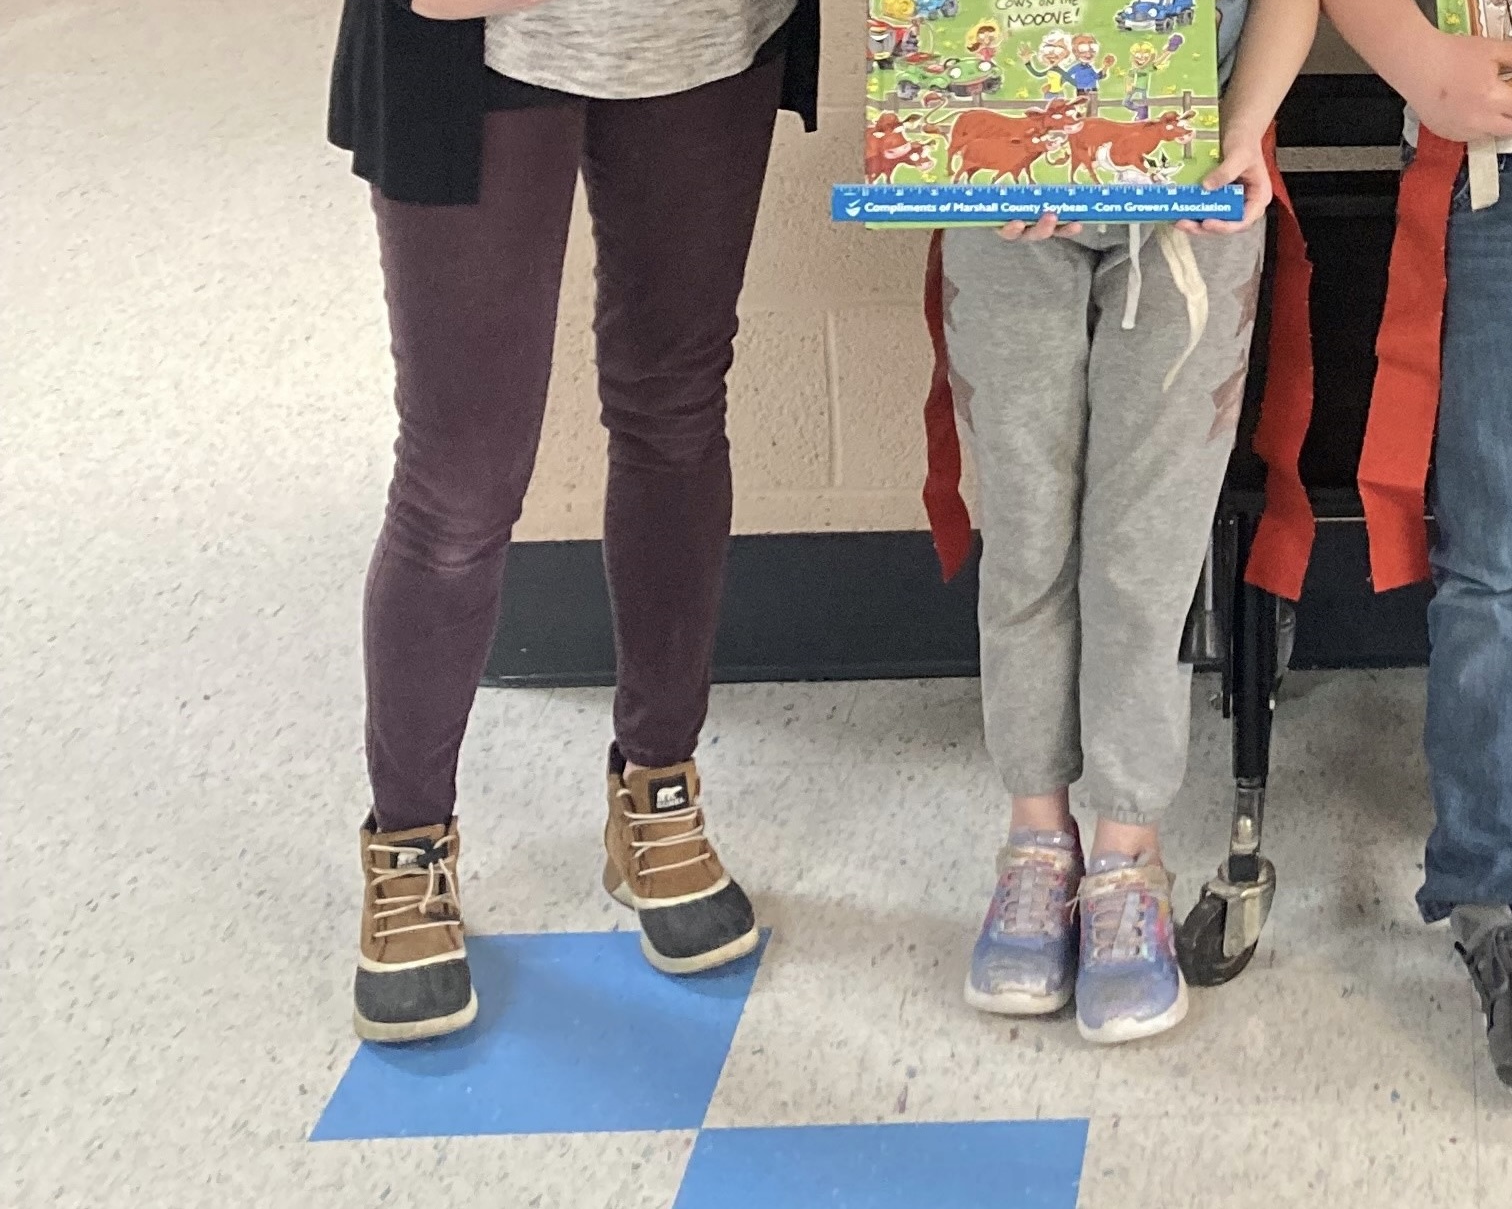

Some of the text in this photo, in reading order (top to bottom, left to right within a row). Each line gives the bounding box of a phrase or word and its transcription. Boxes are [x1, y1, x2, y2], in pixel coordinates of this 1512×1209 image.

[863, 201, 937, 214] Compliments
[939, 201, 952, 213] of
[953, 201, 999, 213] Marshall
[1000, 201, 1041, 215] County
[1043, 201, 1088, 214] Soybean
[1124, 201, 1169, 213] Growers
[1171, 201, 1232, 213] Association
